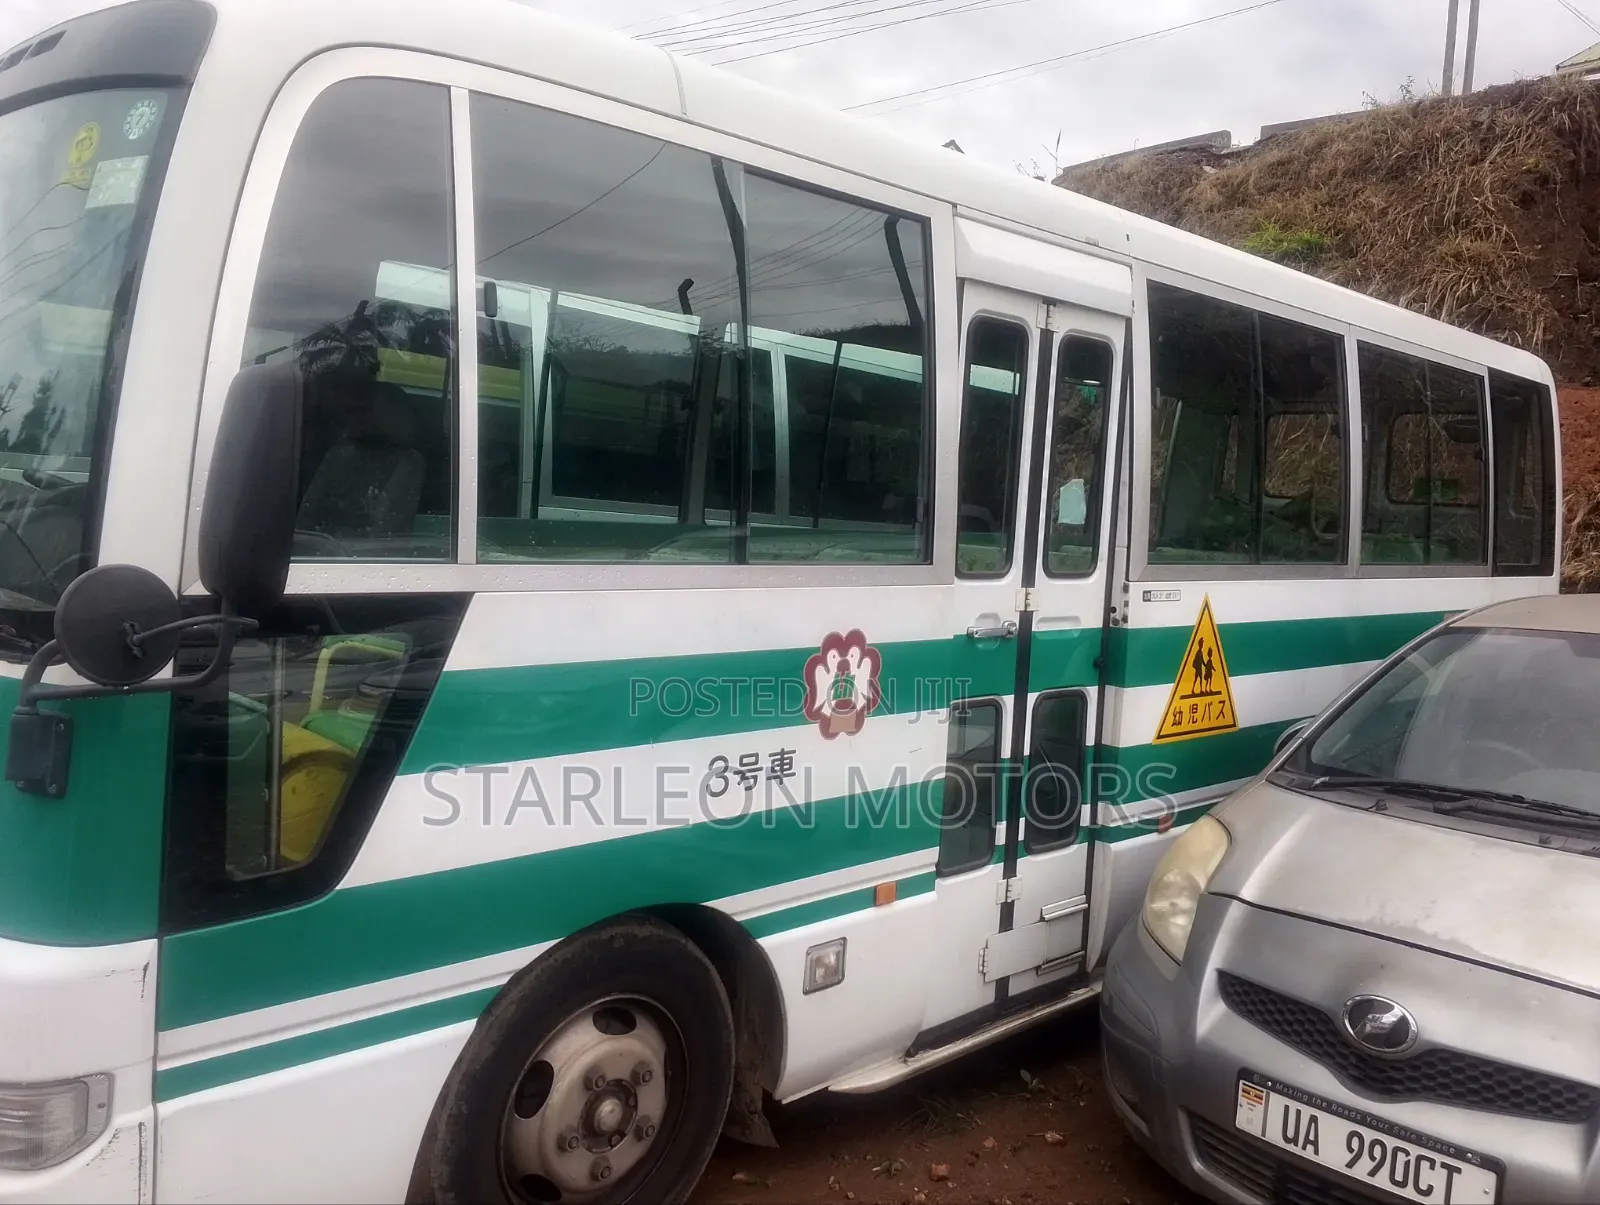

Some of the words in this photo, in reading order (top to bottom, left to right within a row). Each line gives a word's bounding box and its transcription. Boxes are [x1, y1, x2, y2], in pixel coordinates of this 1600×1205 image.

[1171, 700, 1227, 728] 幼児バス
[705, 748, 797, 798] 3号車
[1275, 1083, 1309, 1102] Making
[1311, 1097, 1328, 1108] the
[1331, 1103, 1361, 1120] Roads
[1366, 1115, 1390, 1130] Your
[1393, 1126, 1417, 1141] Safe
[1421, 1136, 1456, 1155] Space
[1281, 1104, 1320, 1156] UA
[1344, 1129, 1462, 1205] 990CT
